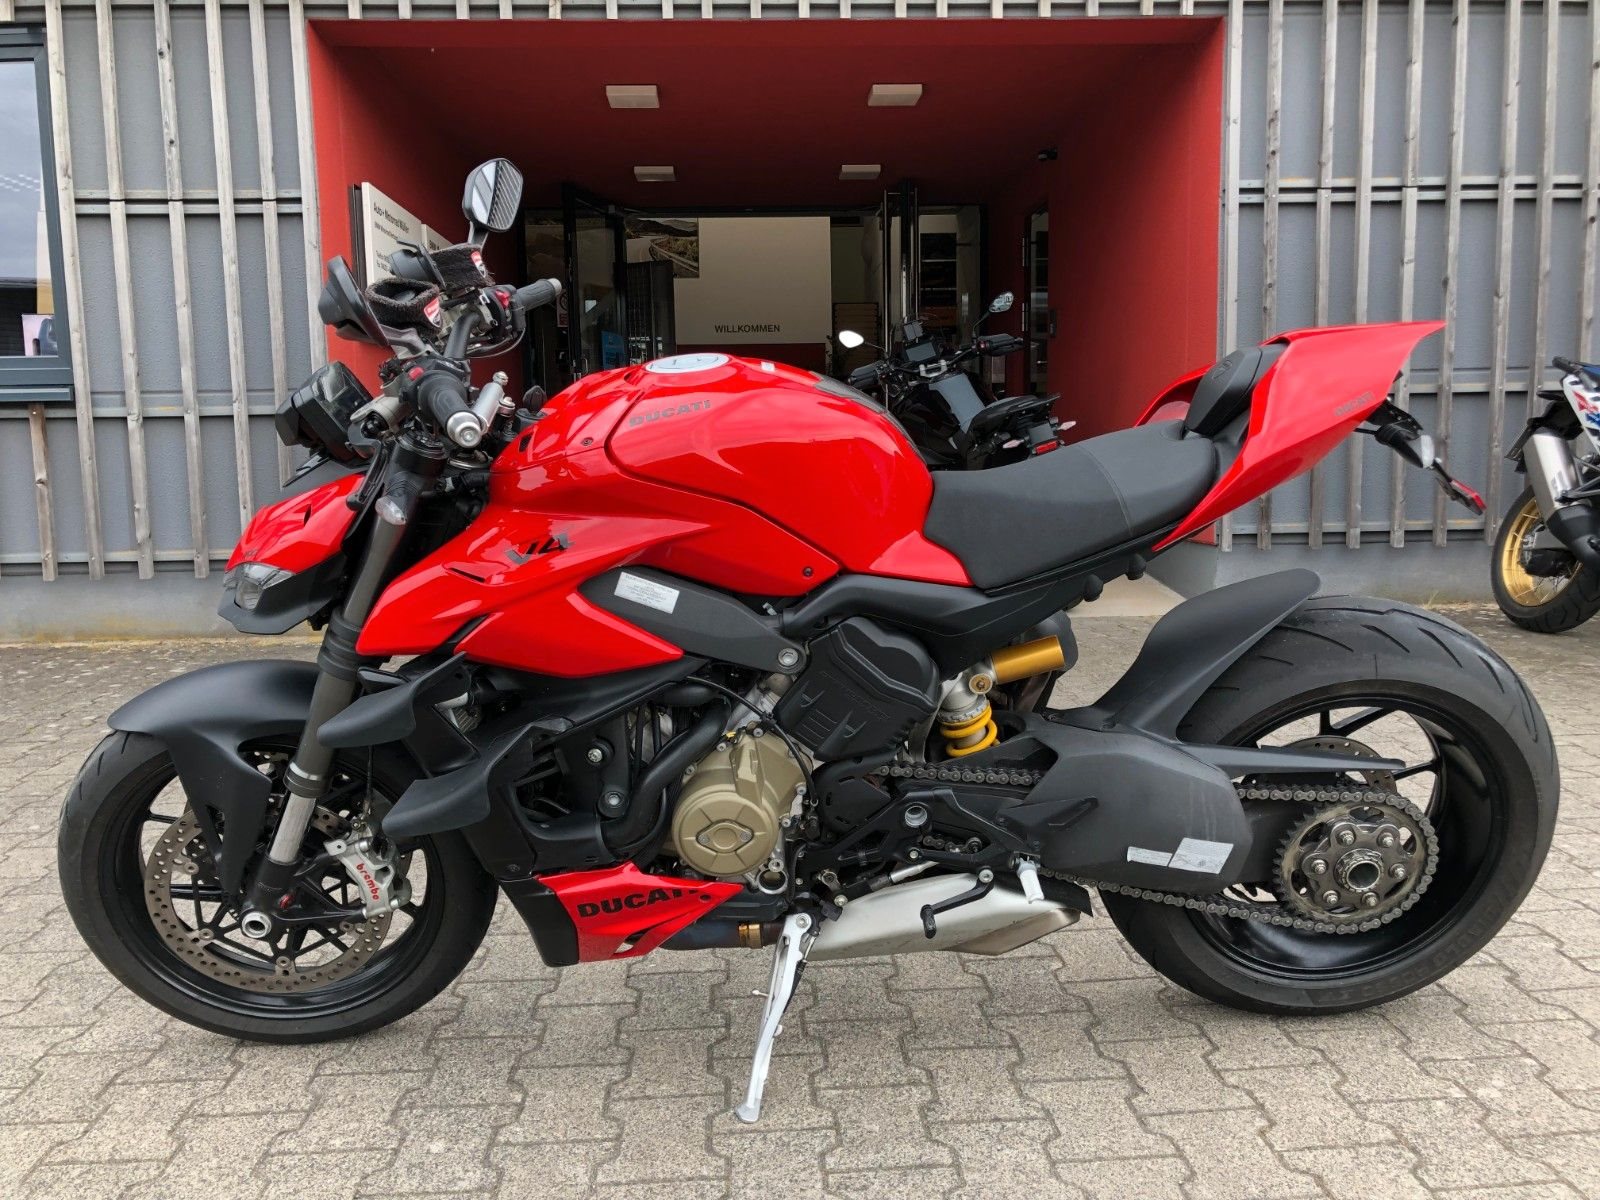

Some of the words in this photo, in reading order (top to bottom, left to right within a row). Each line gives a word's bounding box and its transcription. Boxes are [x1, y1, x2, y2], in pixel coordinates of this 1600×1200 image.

[714, 323, 781, 333] WILLKOMMEN
[628, 399, 712, 427] DUCATI
[356, 863, 380, 900] brembo
